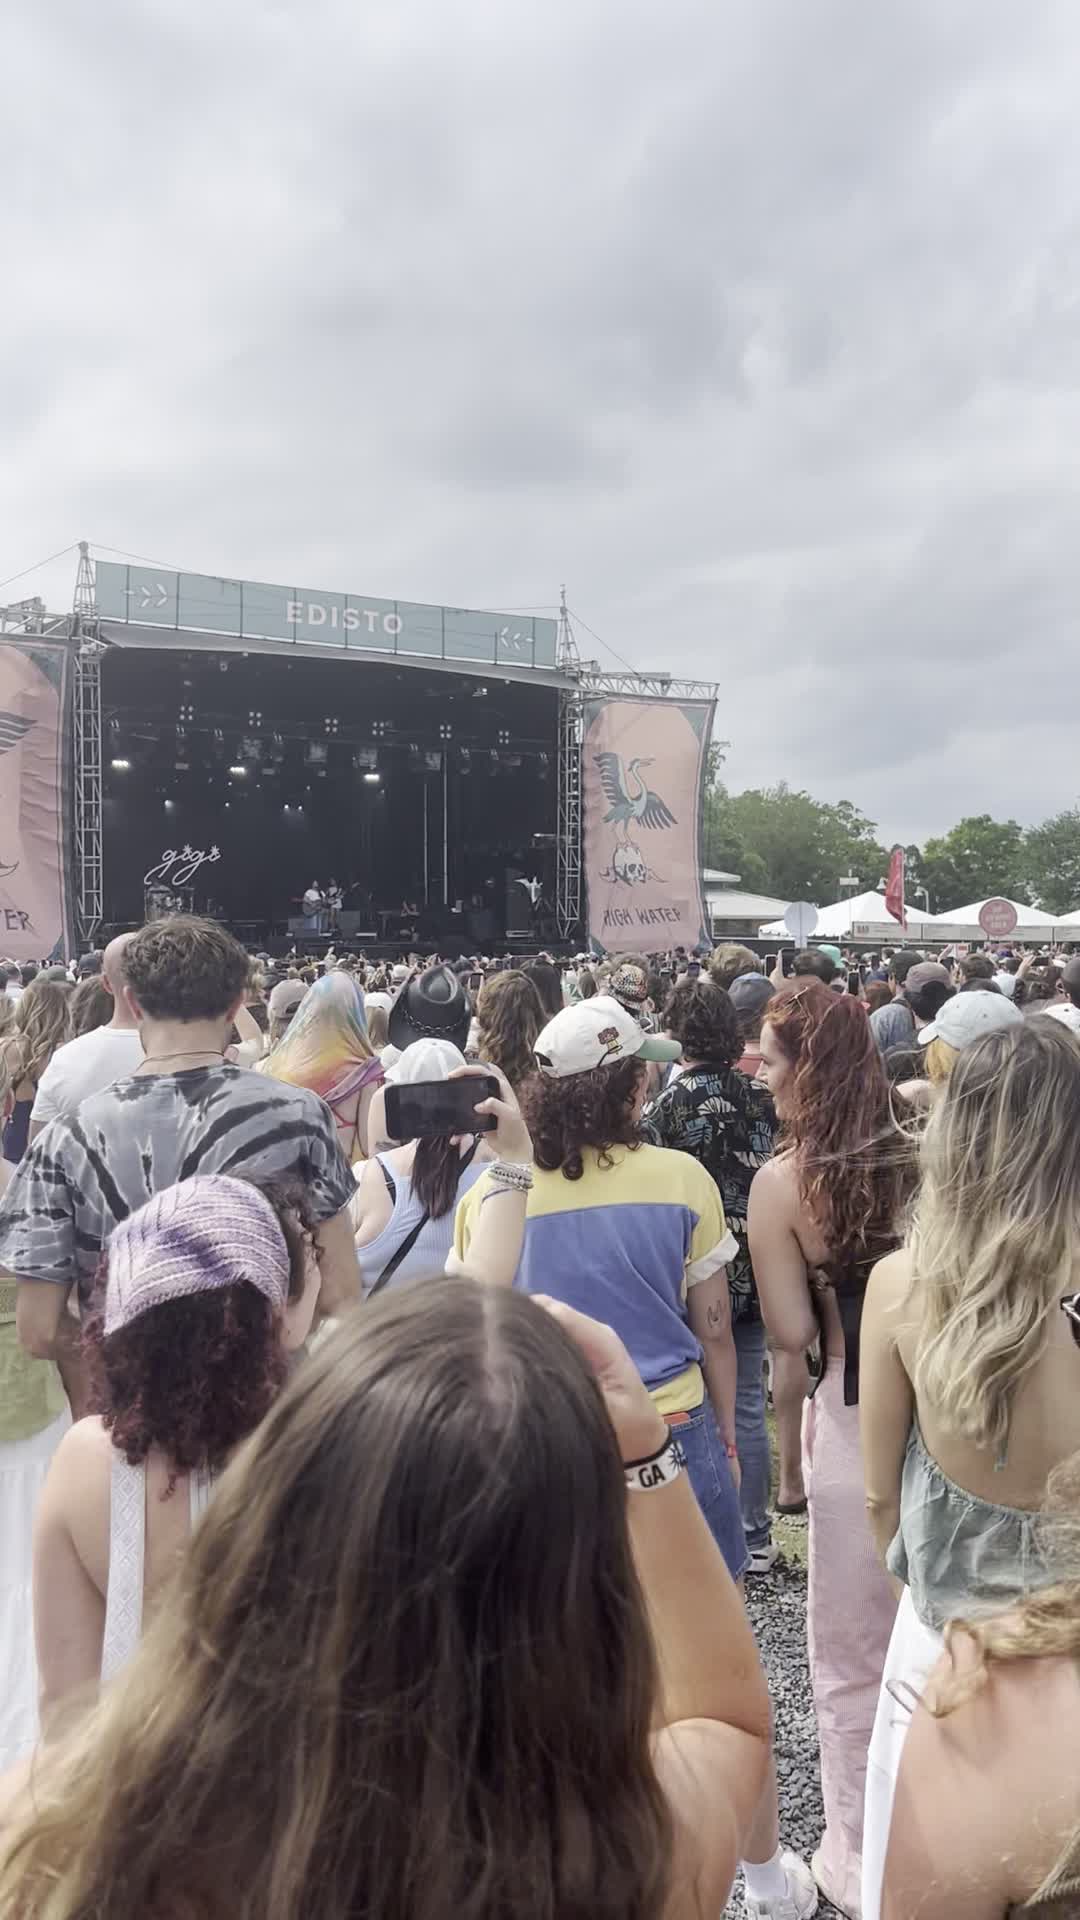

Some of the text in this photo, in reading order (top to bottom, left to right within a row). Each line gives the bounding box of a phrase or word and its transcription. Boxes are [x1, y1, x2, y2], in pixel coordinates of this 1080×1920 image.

[286, 600, 403, 635] EDISTO
[143, 843, 221, 886] gigi
[0, 908, 34, 931] ER
[603, 907, 681, 927] HIGH WATER
[638, 1463, 667, 1488] GA
